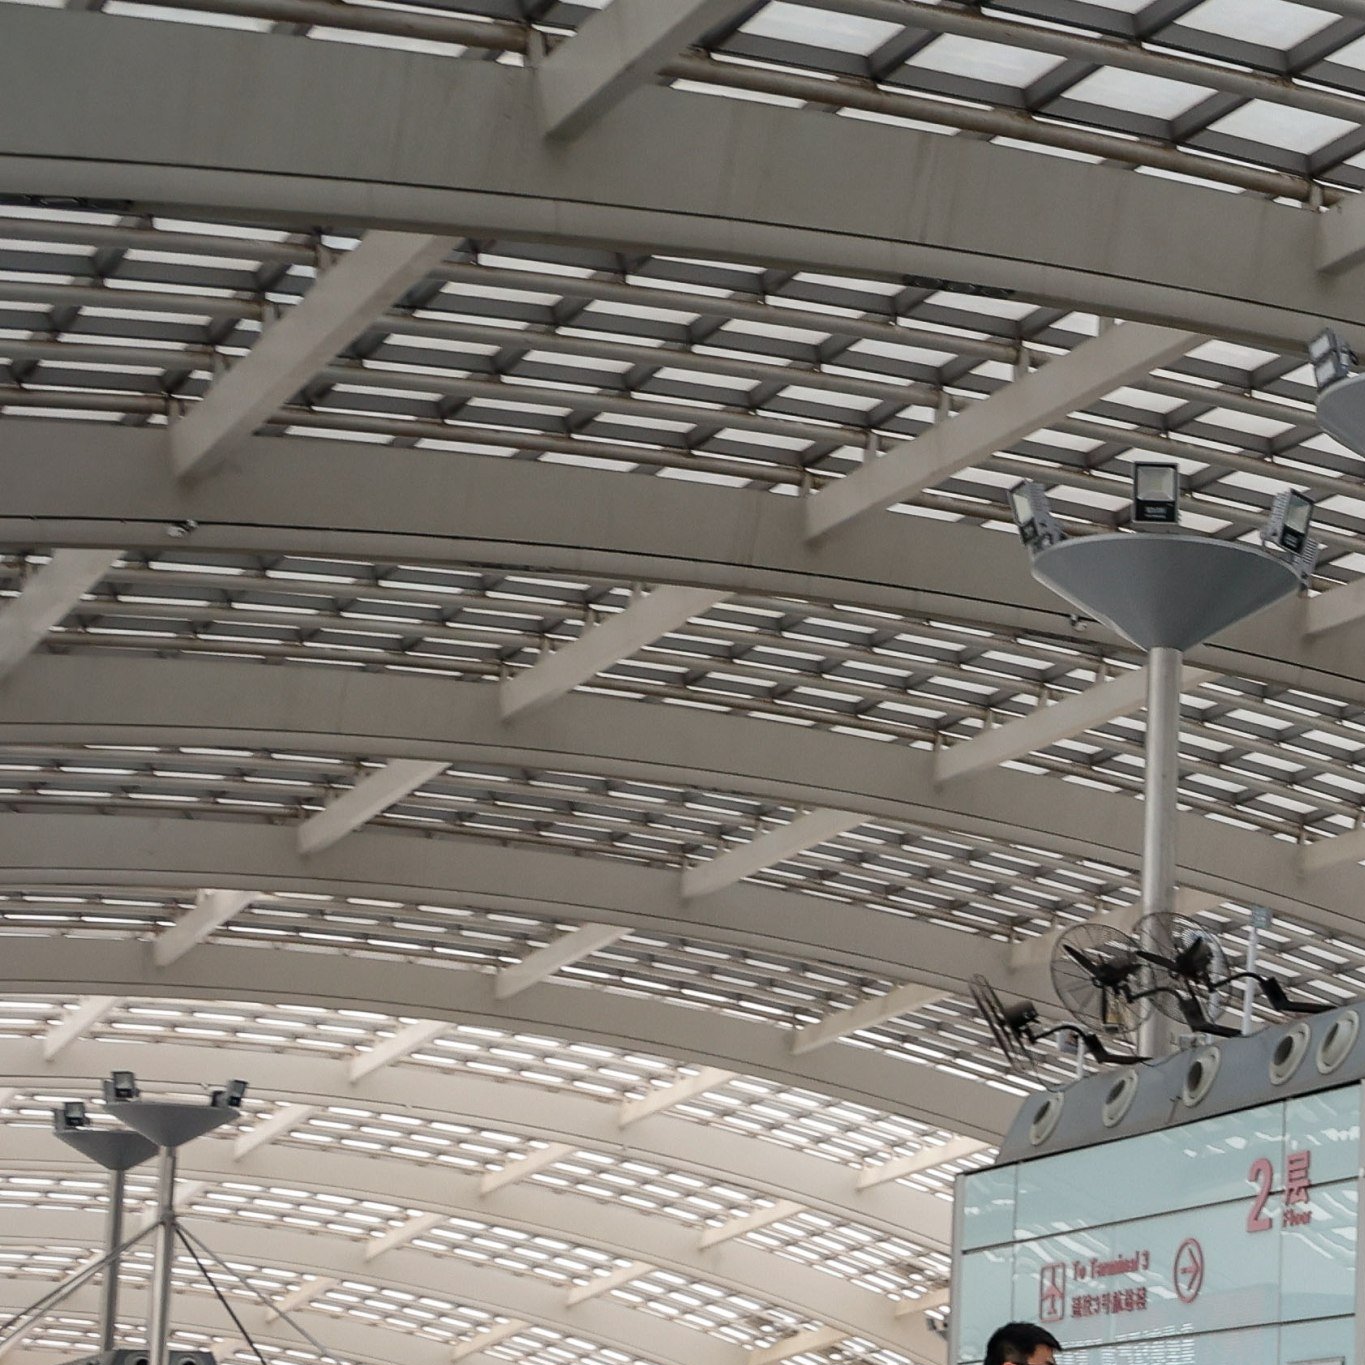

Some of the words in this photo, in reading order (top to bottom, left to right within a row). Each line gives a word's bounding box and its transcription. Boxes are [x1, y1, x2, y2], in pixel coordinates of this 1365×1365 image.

[1246, 1156, 1274, 1233] 2
[1286, 1149, 1312, 1206] 层
[1072, 1259, 1087, 1281] To
[1089, 1250, 1139, 1279] Terminal
[1140, 1250, 1150, 1271] 3
